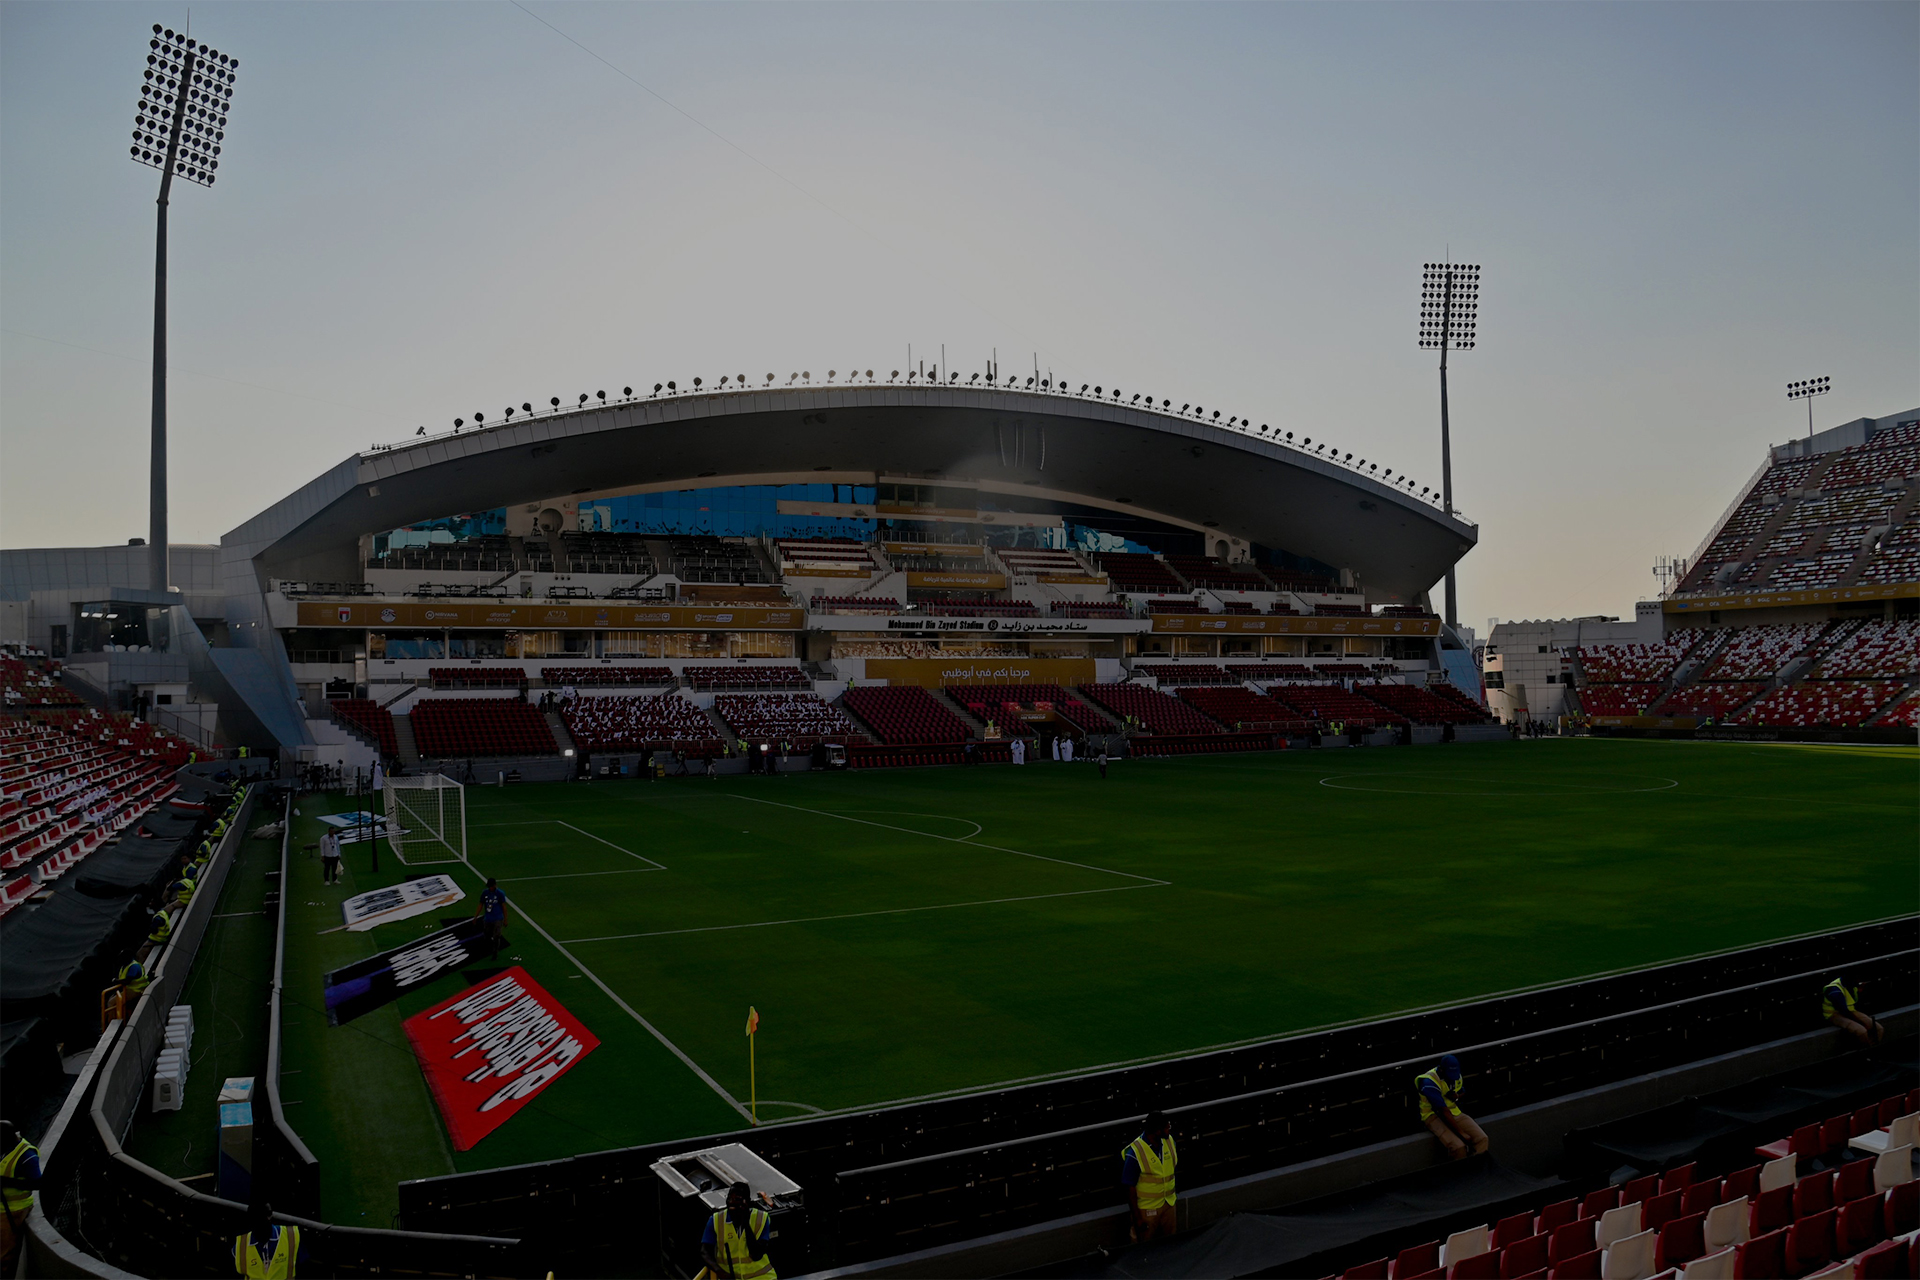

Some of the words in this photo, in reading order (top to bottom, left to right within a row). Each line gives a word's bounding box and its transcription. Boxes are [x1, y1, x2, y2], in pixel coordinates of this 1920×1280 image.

[888, 619, 923, 629] Mohammed
[925, 620, 936, 629] Bin
[938, 620, 957, 631] Zayed
[959, 620, 984, 630] Stadium
[1002, 620, 1022, 632] زايد
[1023, 623, 1035, 631] بن
[1036, 622, 1063, 631] محمد
[1064, 621, 1088, 631] ستاد
[941, 665, 974, 680] أبوظبي
[975, 667, 992, 679] في
[993, 667, 1008, 680] بكم
[387, 932, 470, 987] seven
[427, 974, 527, 1024] and
[451, 993, 566, 1083] etisalat
